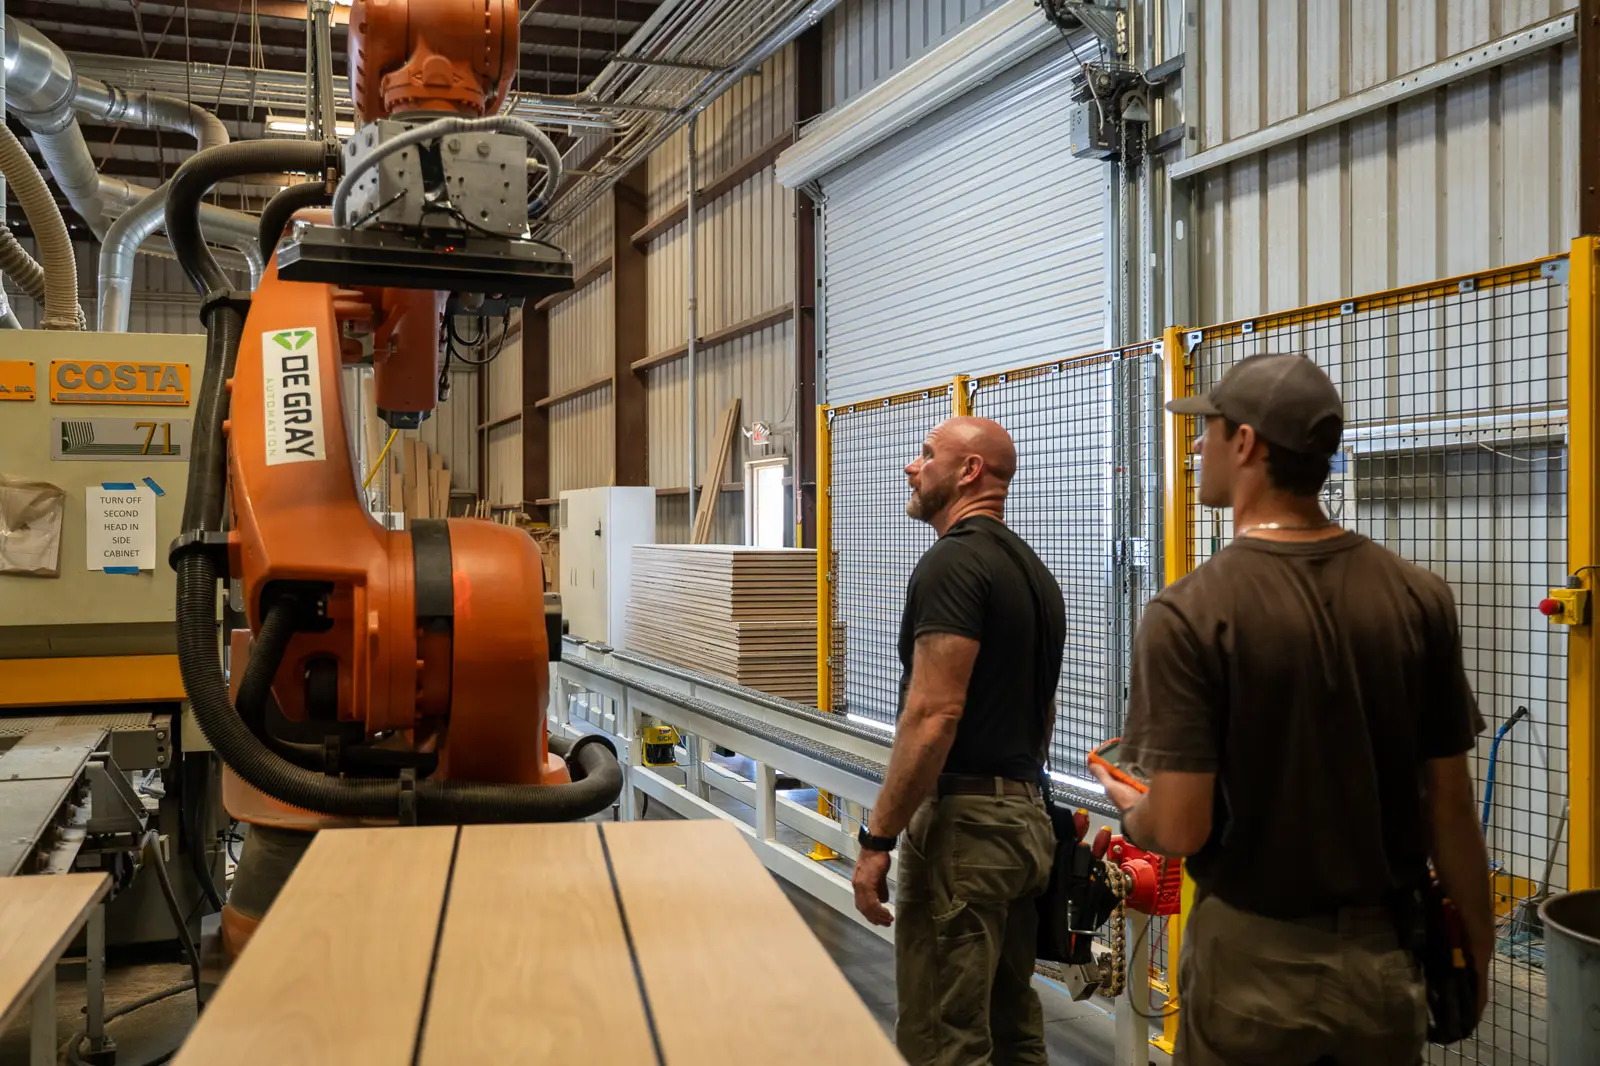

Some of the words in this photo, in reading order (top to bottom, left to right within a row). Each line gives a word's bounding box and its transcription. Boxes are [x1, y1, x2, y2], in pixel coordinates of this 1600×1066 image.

[57, 363, 184, 391] COSTA
[266, 378, 277, 456] AUTOMATION
[134, 422, 175, 455] 71
[104, 510, 139, 518] SECOND
